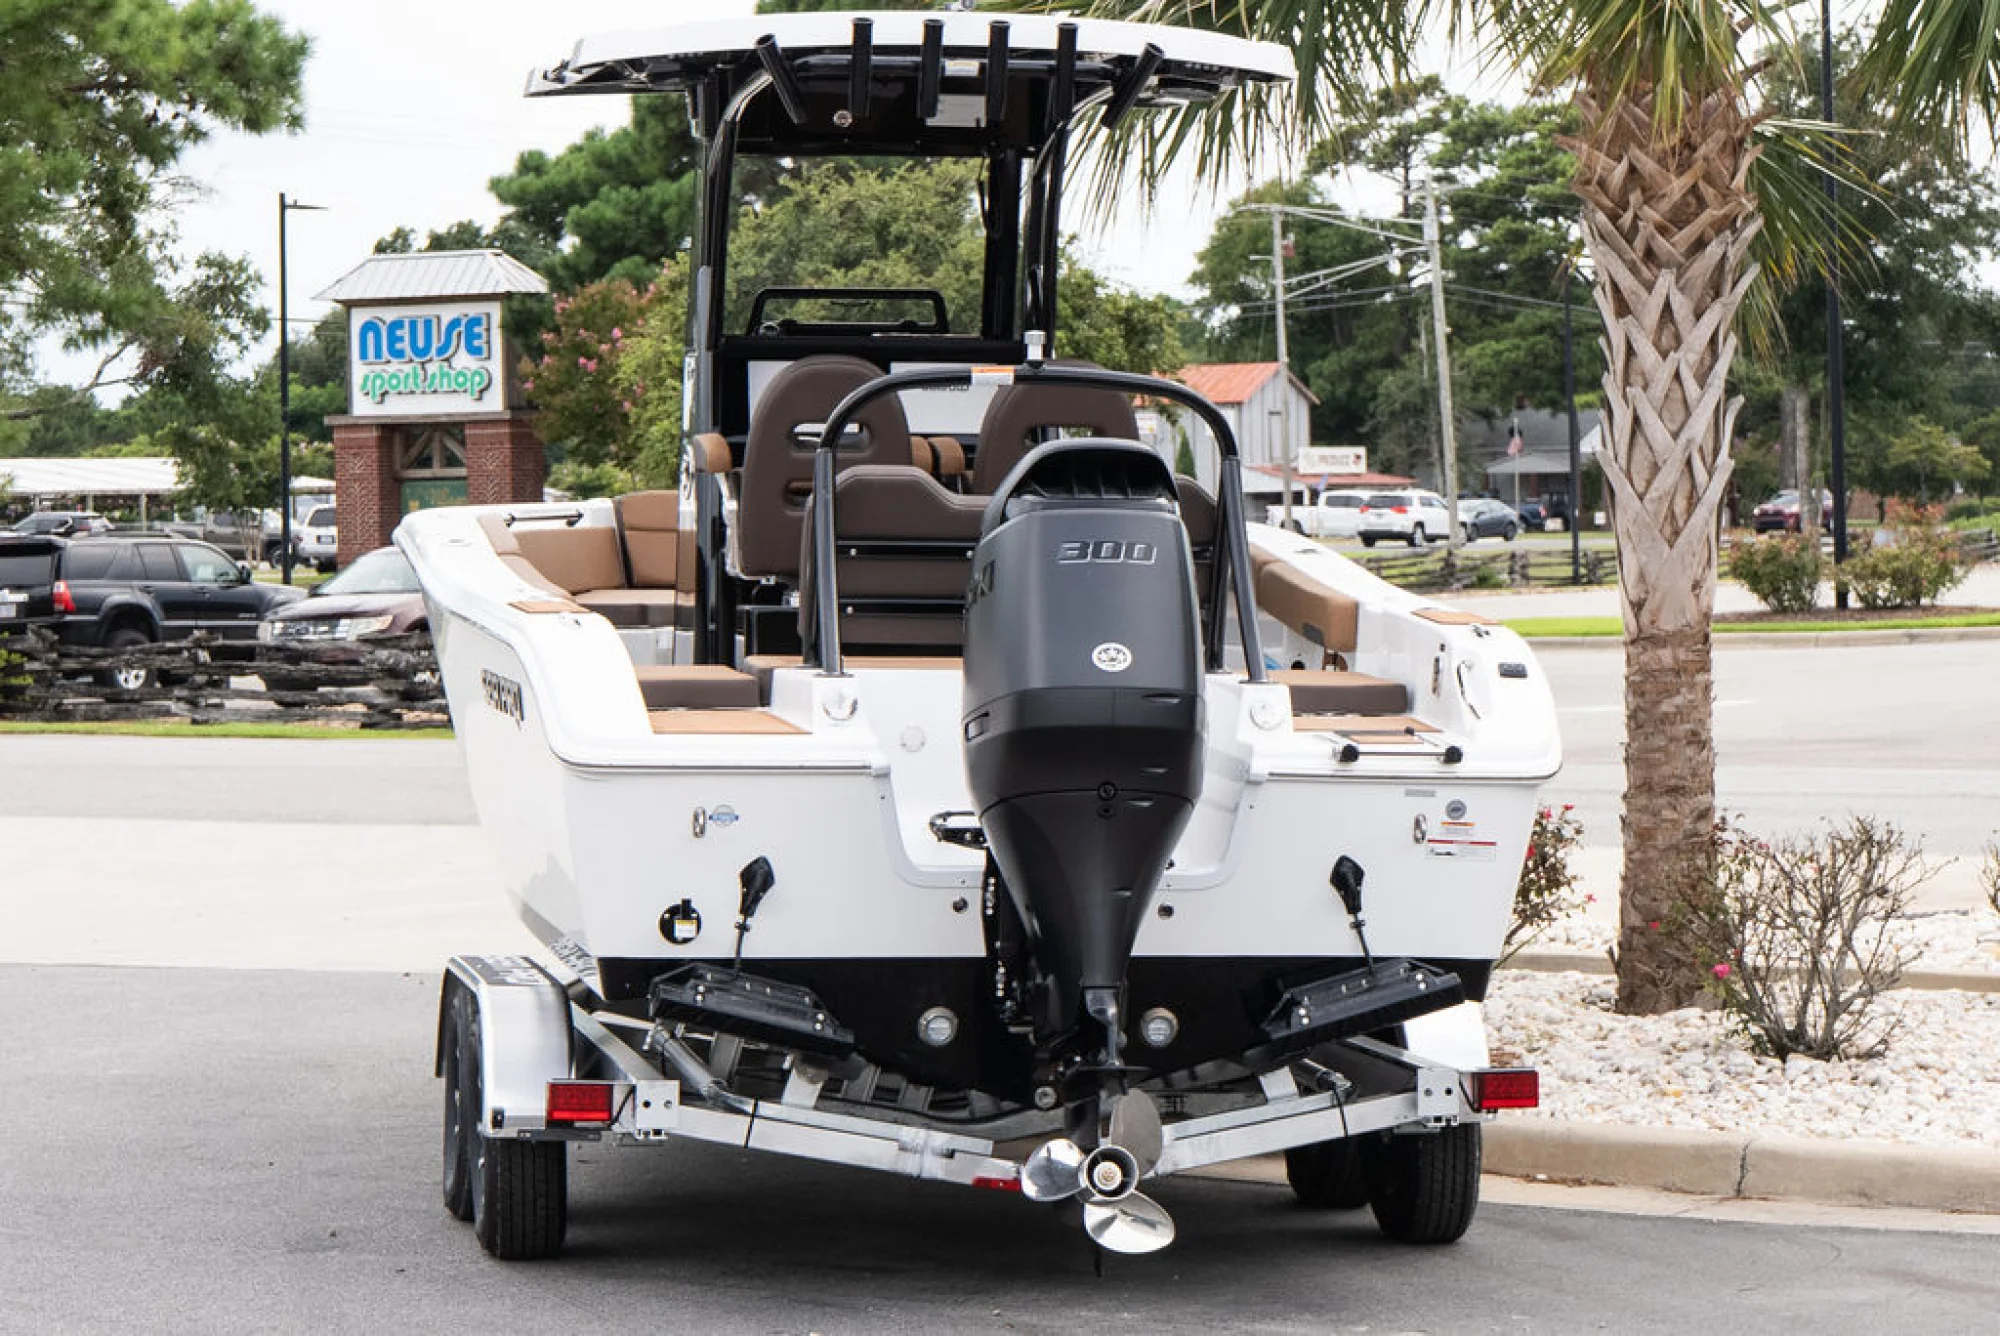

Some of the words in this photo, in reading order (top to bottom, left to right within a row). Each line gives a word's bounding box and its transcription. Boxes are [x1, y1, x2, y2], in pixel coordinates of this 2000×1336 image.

[358, 315, 485, 361] NEUSE
[360, 364, 421, 401] sport
[426, 363, 486, 398] shop
[1058, 540, 1157, 565] 300
